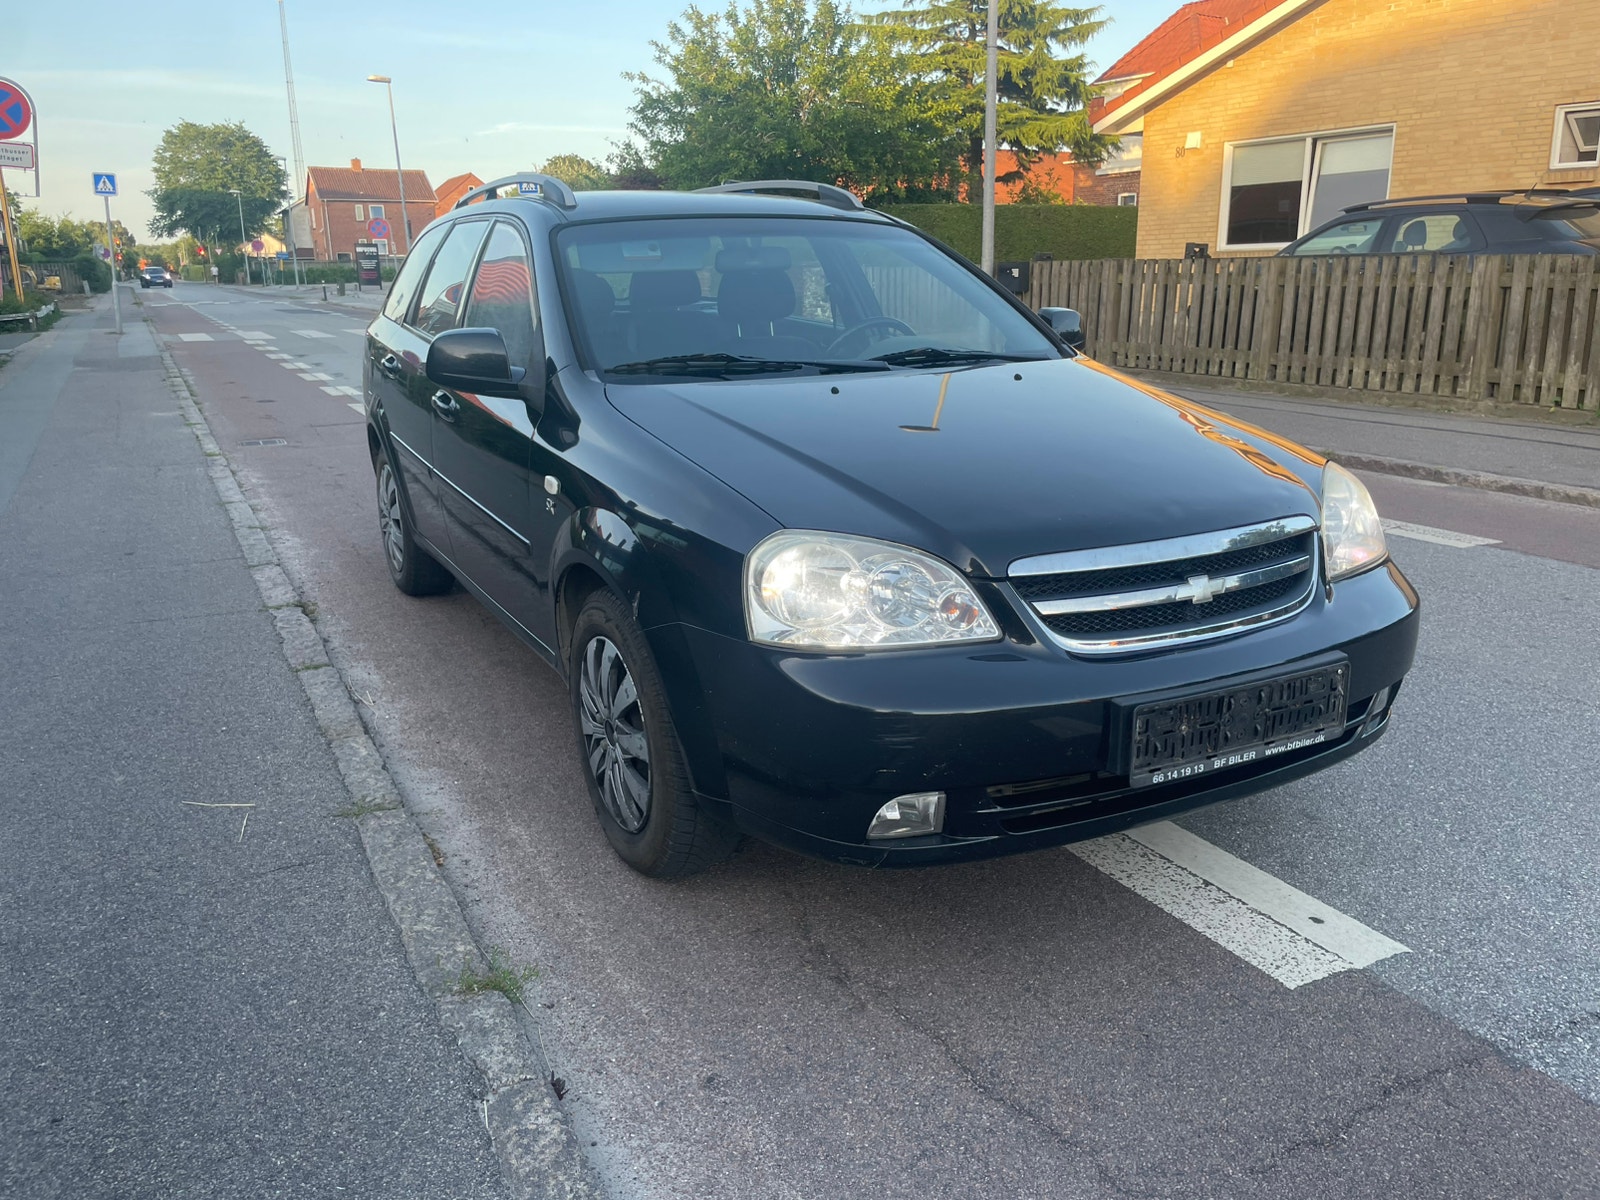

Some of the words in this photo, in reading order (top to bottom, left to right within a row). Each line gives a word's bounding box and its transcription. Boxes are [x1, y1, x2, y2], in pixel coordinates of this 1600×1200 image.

[1175, 146, 1186, 158] 80
[1152, 774, 1164, 784] 66
[1167, 770, 1178, 780] 14
[1181, 767, 1191, 777] 19
[1194, 763, 1205, 773] 13
[1214, 758, 1226, 769] BF
[1228, 751, 1256, 766] BILER
[1265, 734, 1326, 756] www.bfbiler.dk
